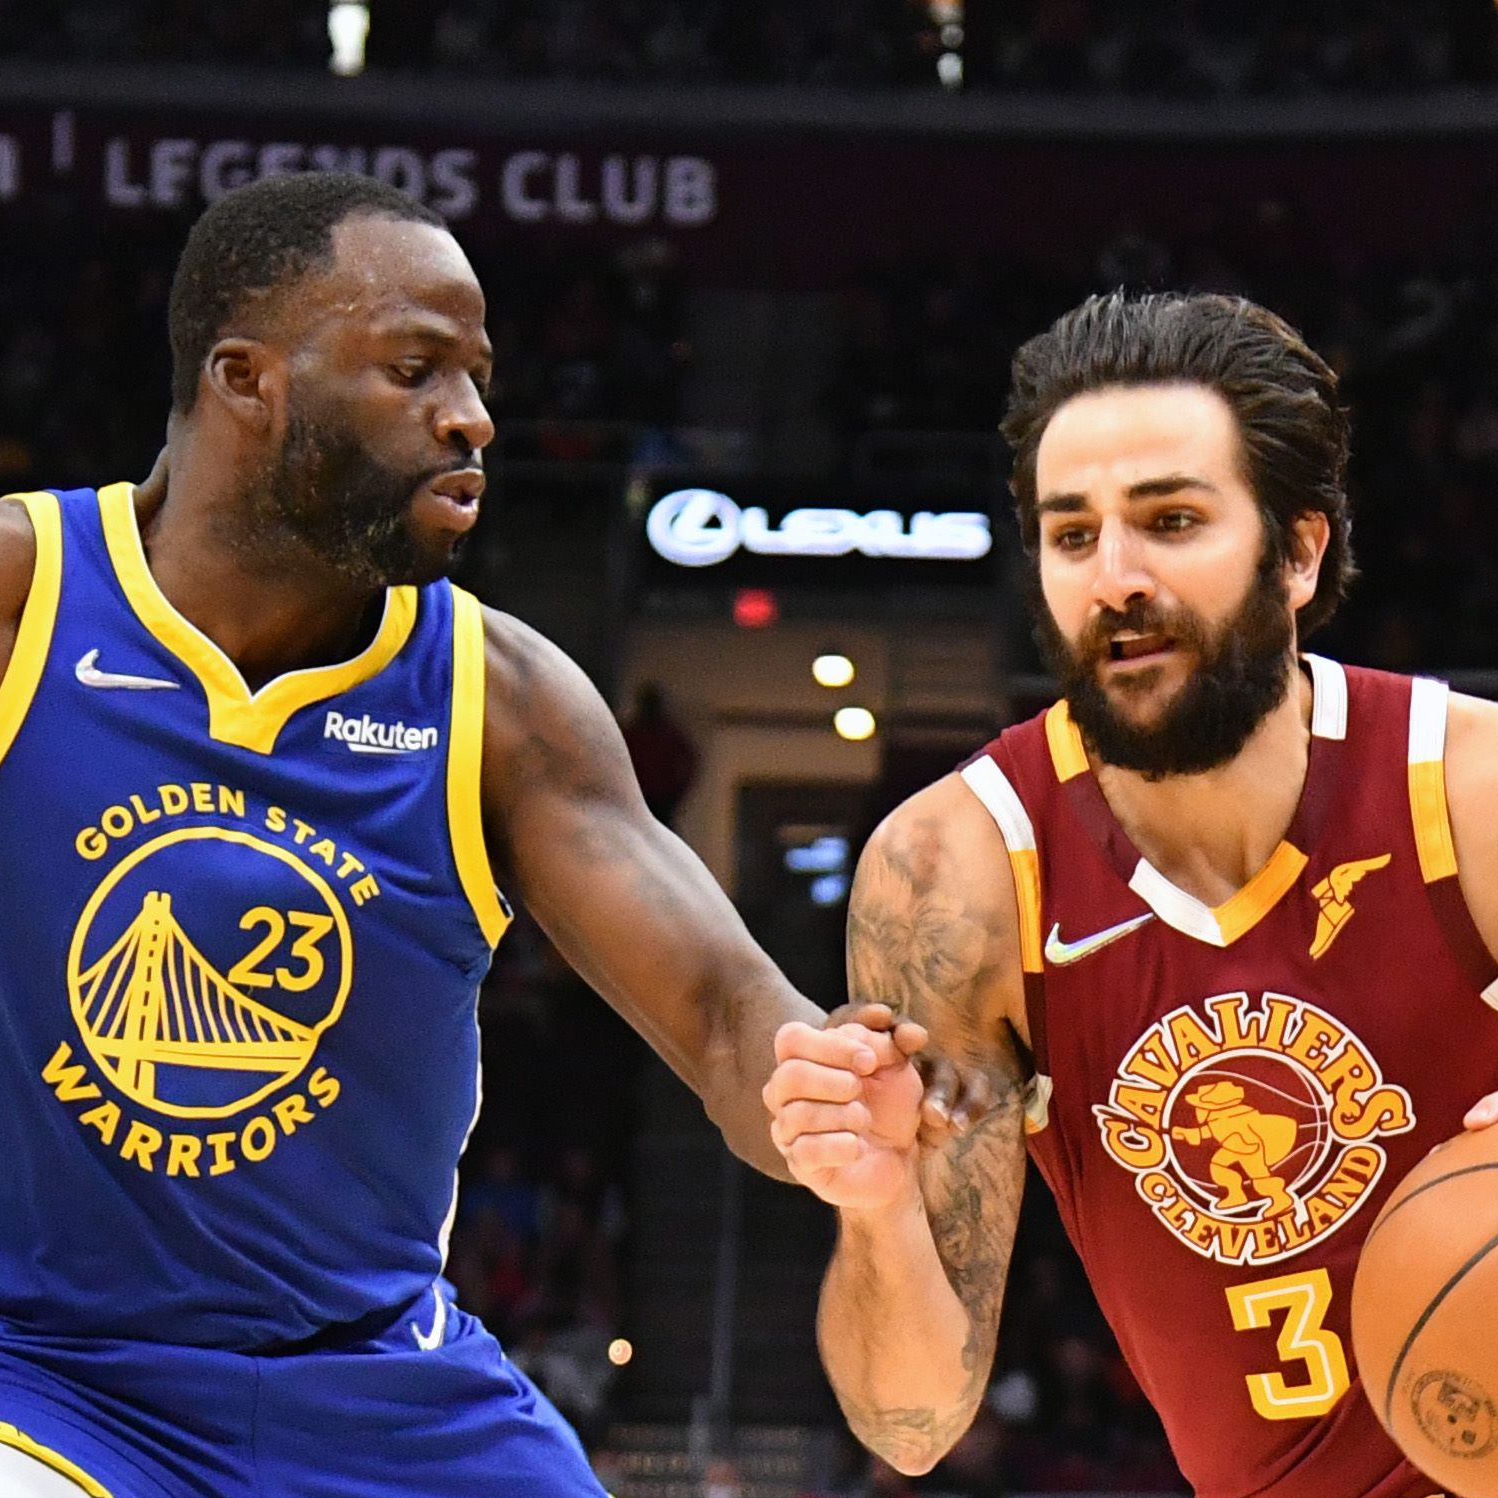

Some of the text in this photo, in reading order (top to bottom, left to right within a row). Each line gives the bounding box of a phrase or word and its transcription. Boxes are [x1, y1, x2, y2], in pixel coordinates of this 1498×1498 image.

[500, 150, 721, 227] CLUB
[742, 506, 994, 561] LEXUS
[324, 711, 438, 753] Rakuten
[75, 782, 381, 907] GOLDEN STATE
[228, 906, 334, 991] 23
[41, 1040, 342, 1178] WARRIORS
[1098, 994, 1414, 1170] CAVALIERS
[1140, 1145, 1382, 1260] CLEVELAND
[1224, 1267, 1351, 1421] 3
